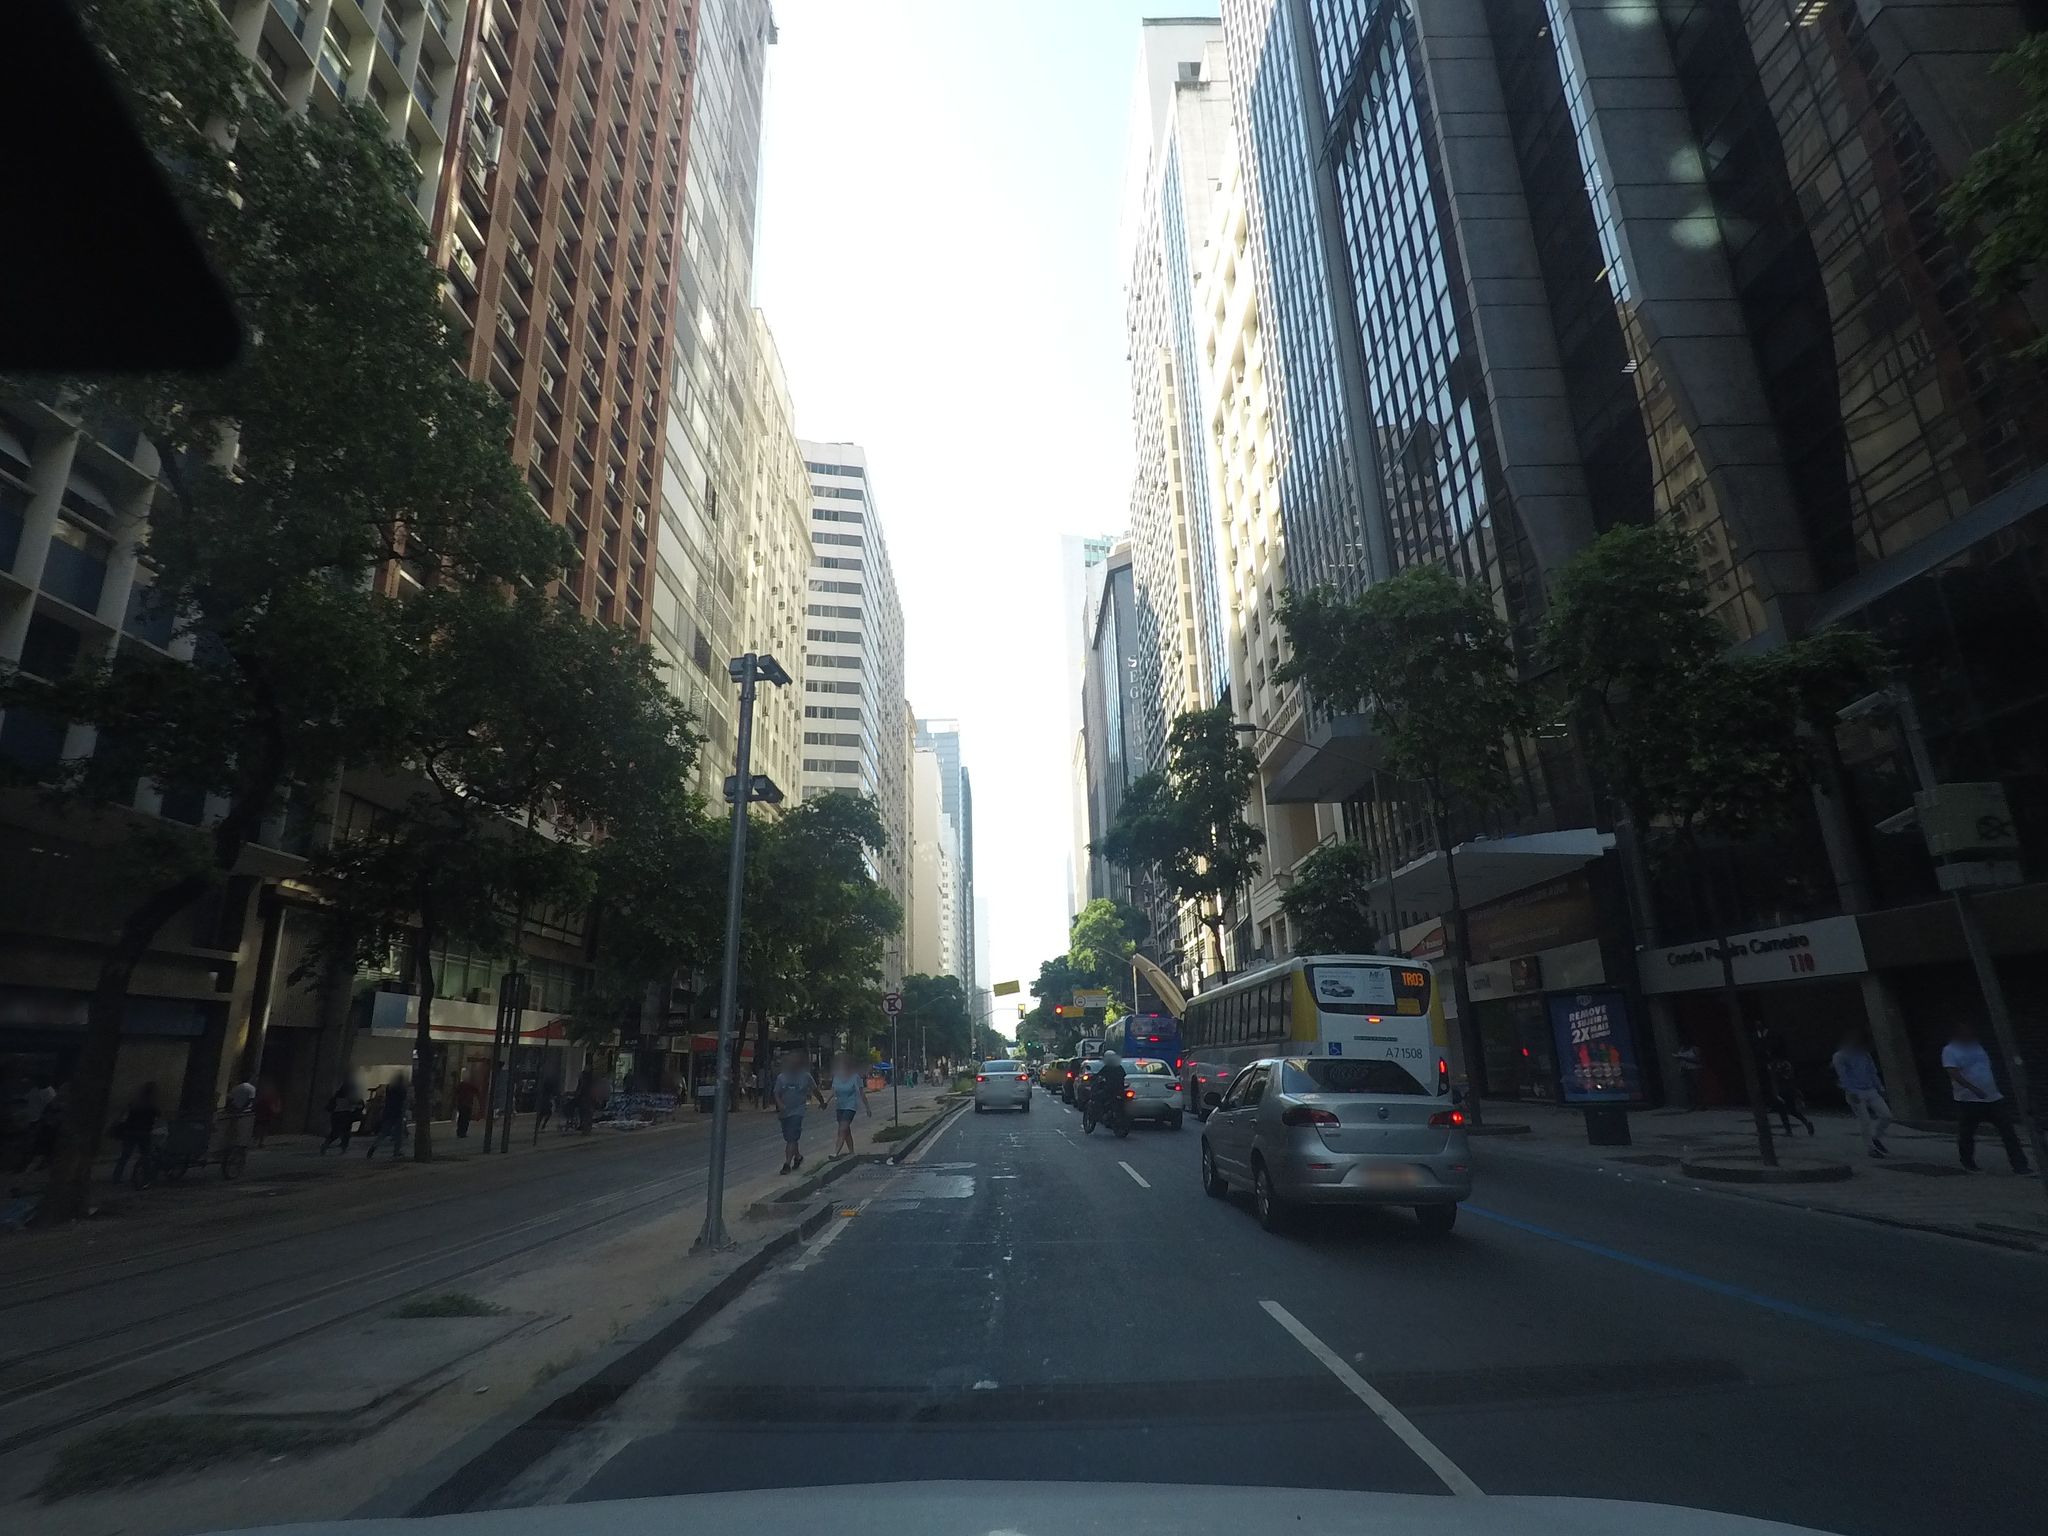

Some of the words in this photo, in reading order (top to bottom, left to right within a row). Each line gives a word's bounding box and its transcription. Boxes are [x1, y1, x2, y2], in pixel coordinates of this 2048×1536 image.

[1127, 654, 1144, 762] SEGUROS
[1400, 970, 1425, 987] TR03
[1569, 1004, 1607, 1022] REMOVE
[1571, 1027, 1590, 1044] 2X
[1385, 1047, 1423, 1059] A71508
